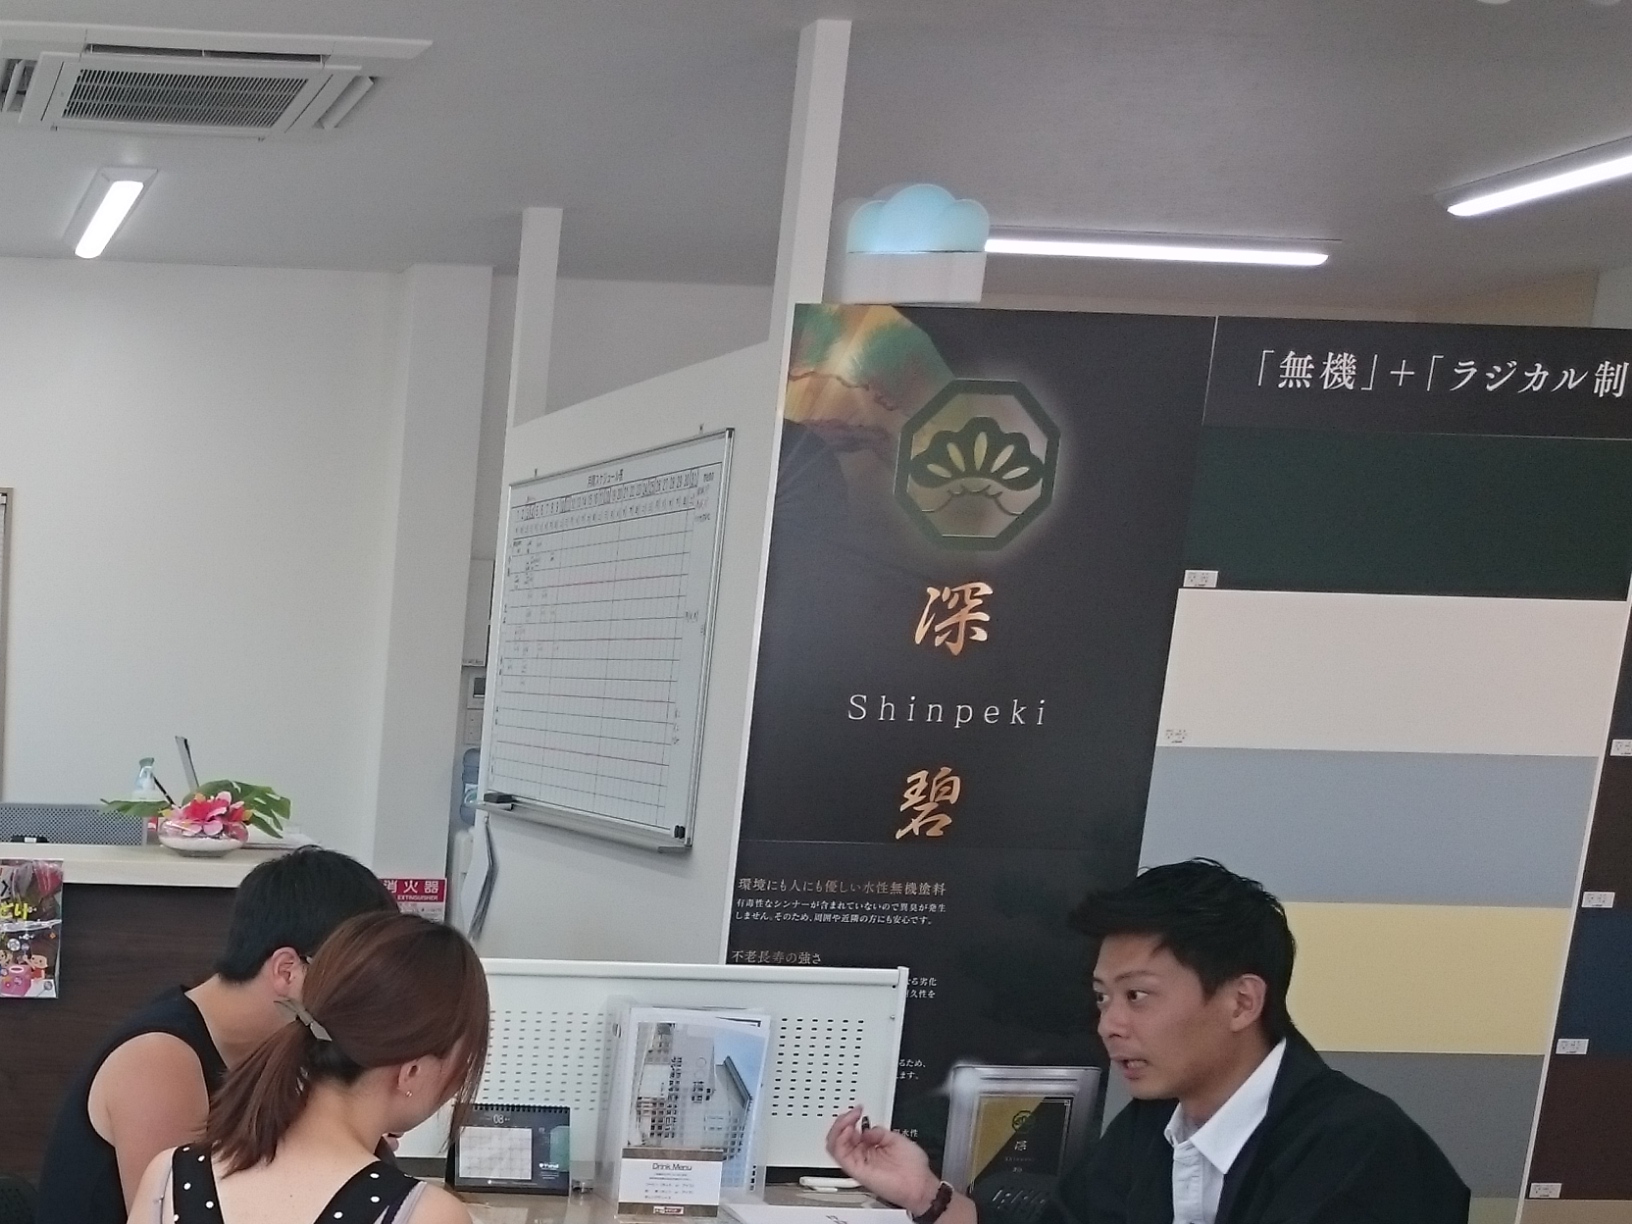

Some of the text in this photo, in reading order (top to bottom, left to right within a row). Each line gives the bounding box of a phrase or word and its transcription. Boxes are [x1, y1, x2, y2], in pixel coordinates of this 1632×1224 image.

[913, 582, 993, 656] 深
[846, 692, 1048, 730] Shinpeki
[894, 767, 963, 842] 碧
[737, 877, 946, 896] 環境にも人にも優しい水性無機塗料
[731, 949, 822, 965] 不老長寿の強さ
[906, 989, 936, 999] 久性を
[673, 1163, 692, 1171] Menu
